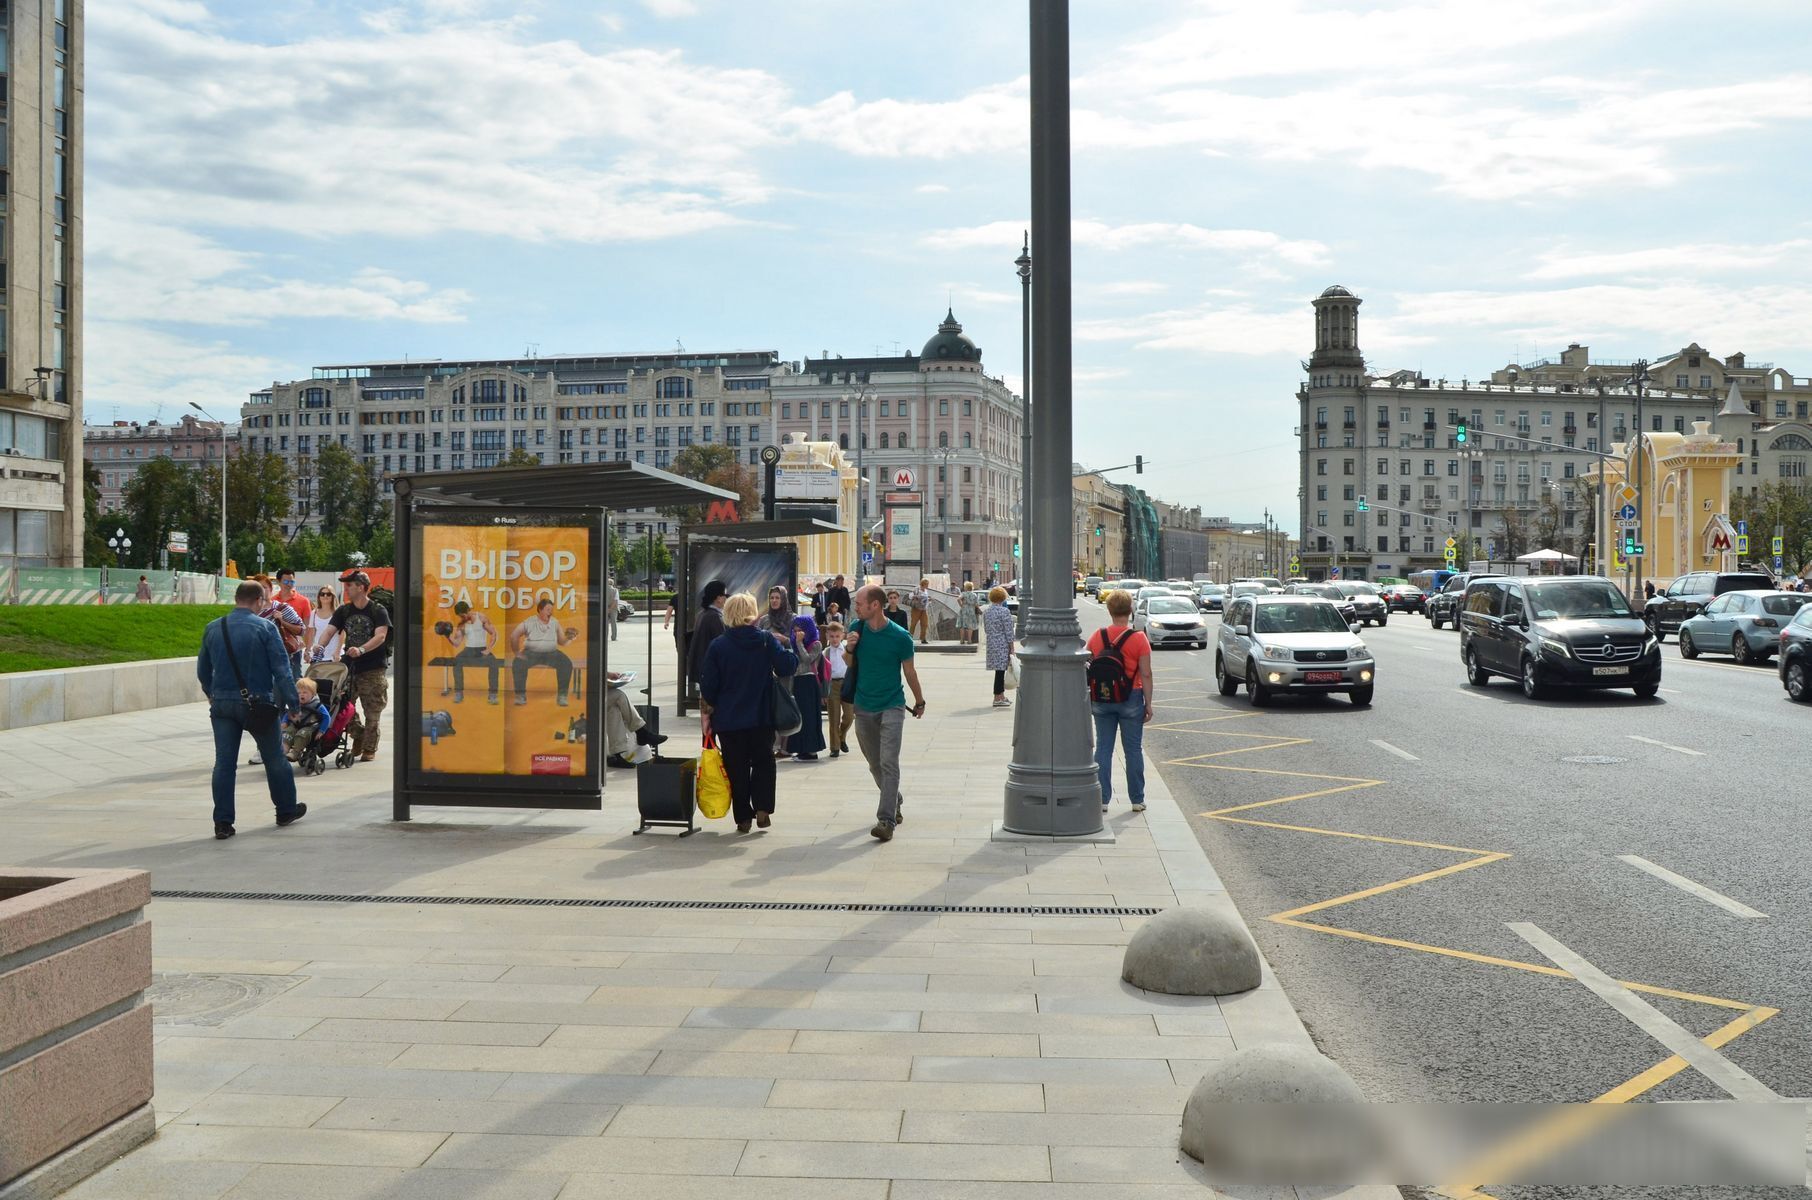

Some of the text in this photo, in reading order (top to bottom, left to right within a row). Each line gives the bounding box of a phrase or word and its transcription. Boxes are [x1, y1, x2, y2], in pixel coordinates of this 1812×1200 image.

[440, 549, 577, 581] ВЫБОР
[438, 583, 577, 611] ЗА ТОБОЙ
